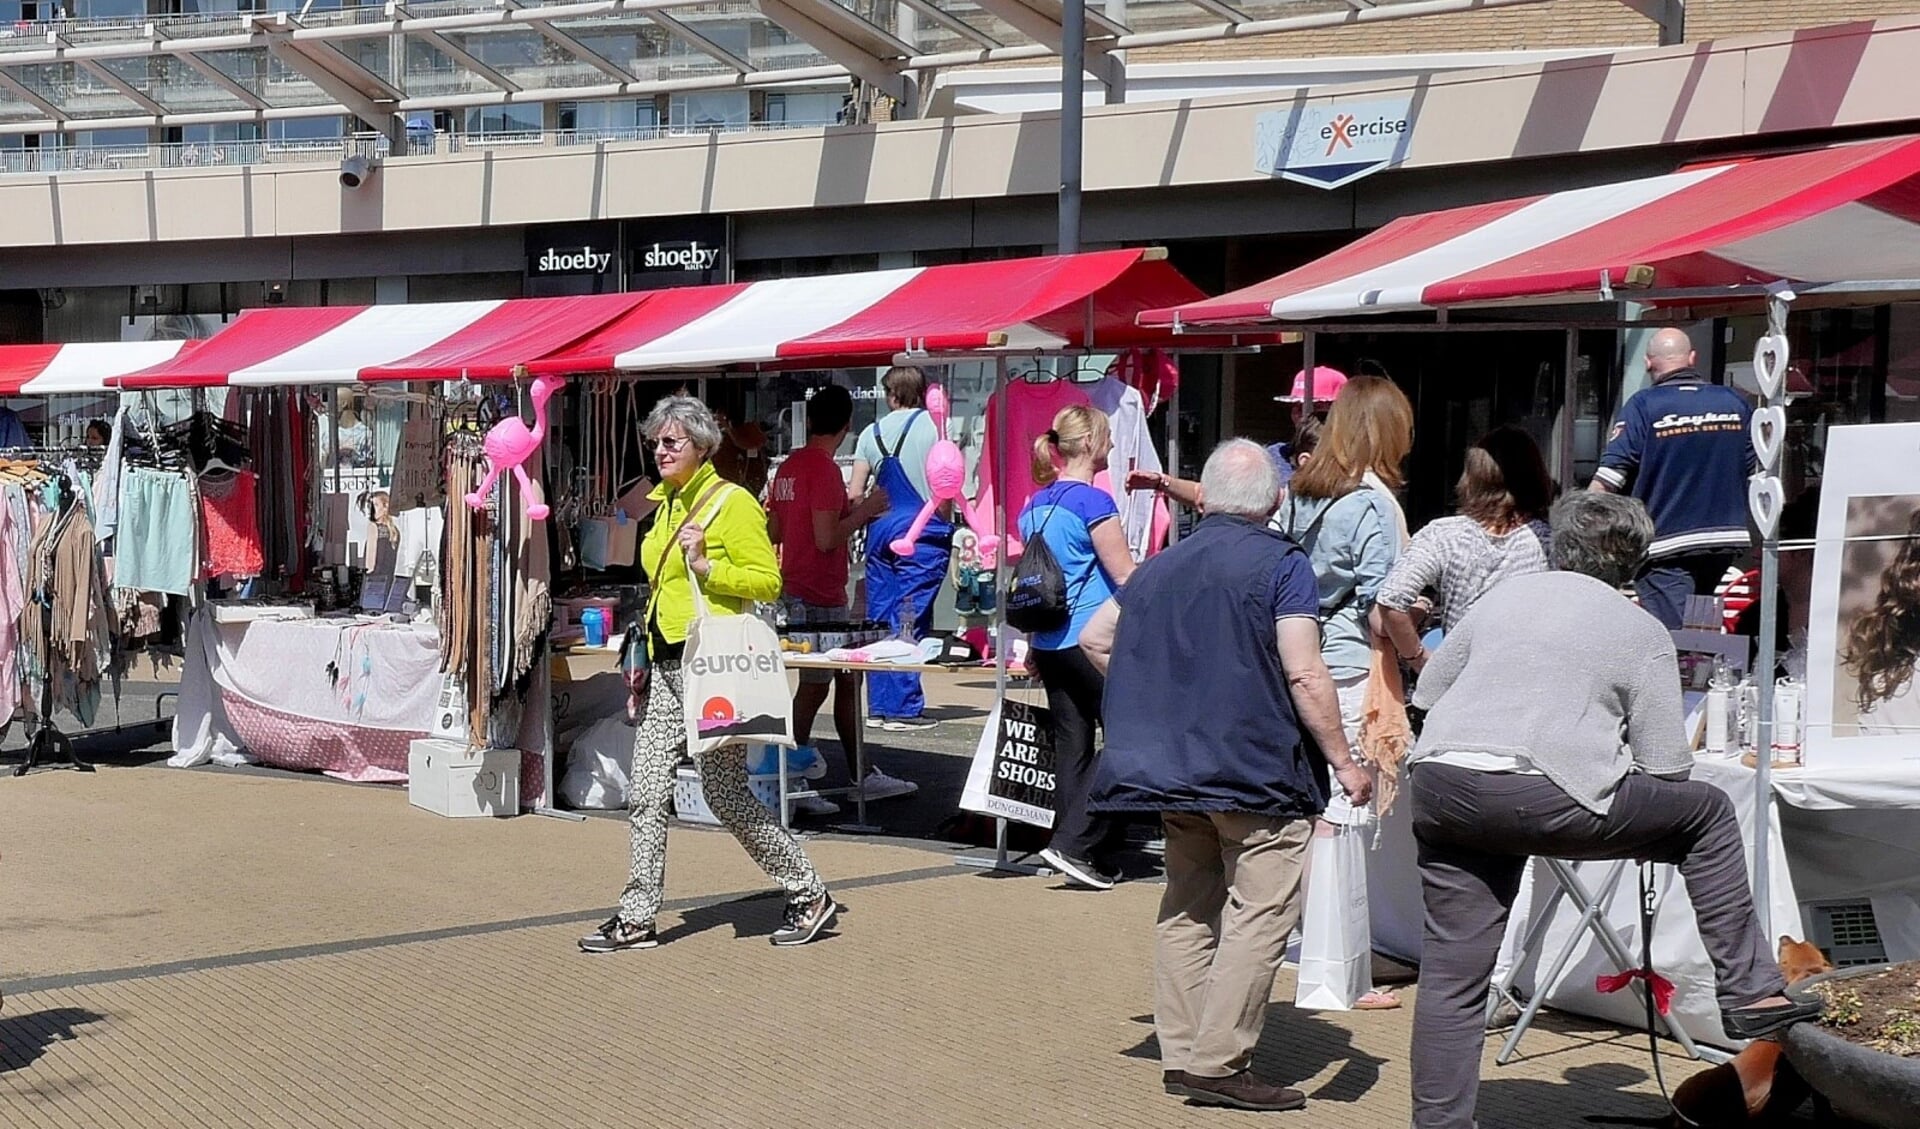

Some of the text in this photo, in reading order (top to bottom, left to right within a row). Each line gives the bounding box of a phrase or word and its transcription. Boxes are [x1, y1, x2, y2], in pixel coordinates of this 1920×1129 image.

[1320, 114, 1408, 157] eXercise
[538, 246, 612, 273] shoeby
[644, 241, 719, 270] shoeby
[690, 645, 779, 681] eurojet
[1004, 718, 1037, 742] WE
[999, 740, 1040, 765] ARE
[997, 760, 1057, 791] SHOES
[986, 798, 1053, 824] DUNGELMANN
